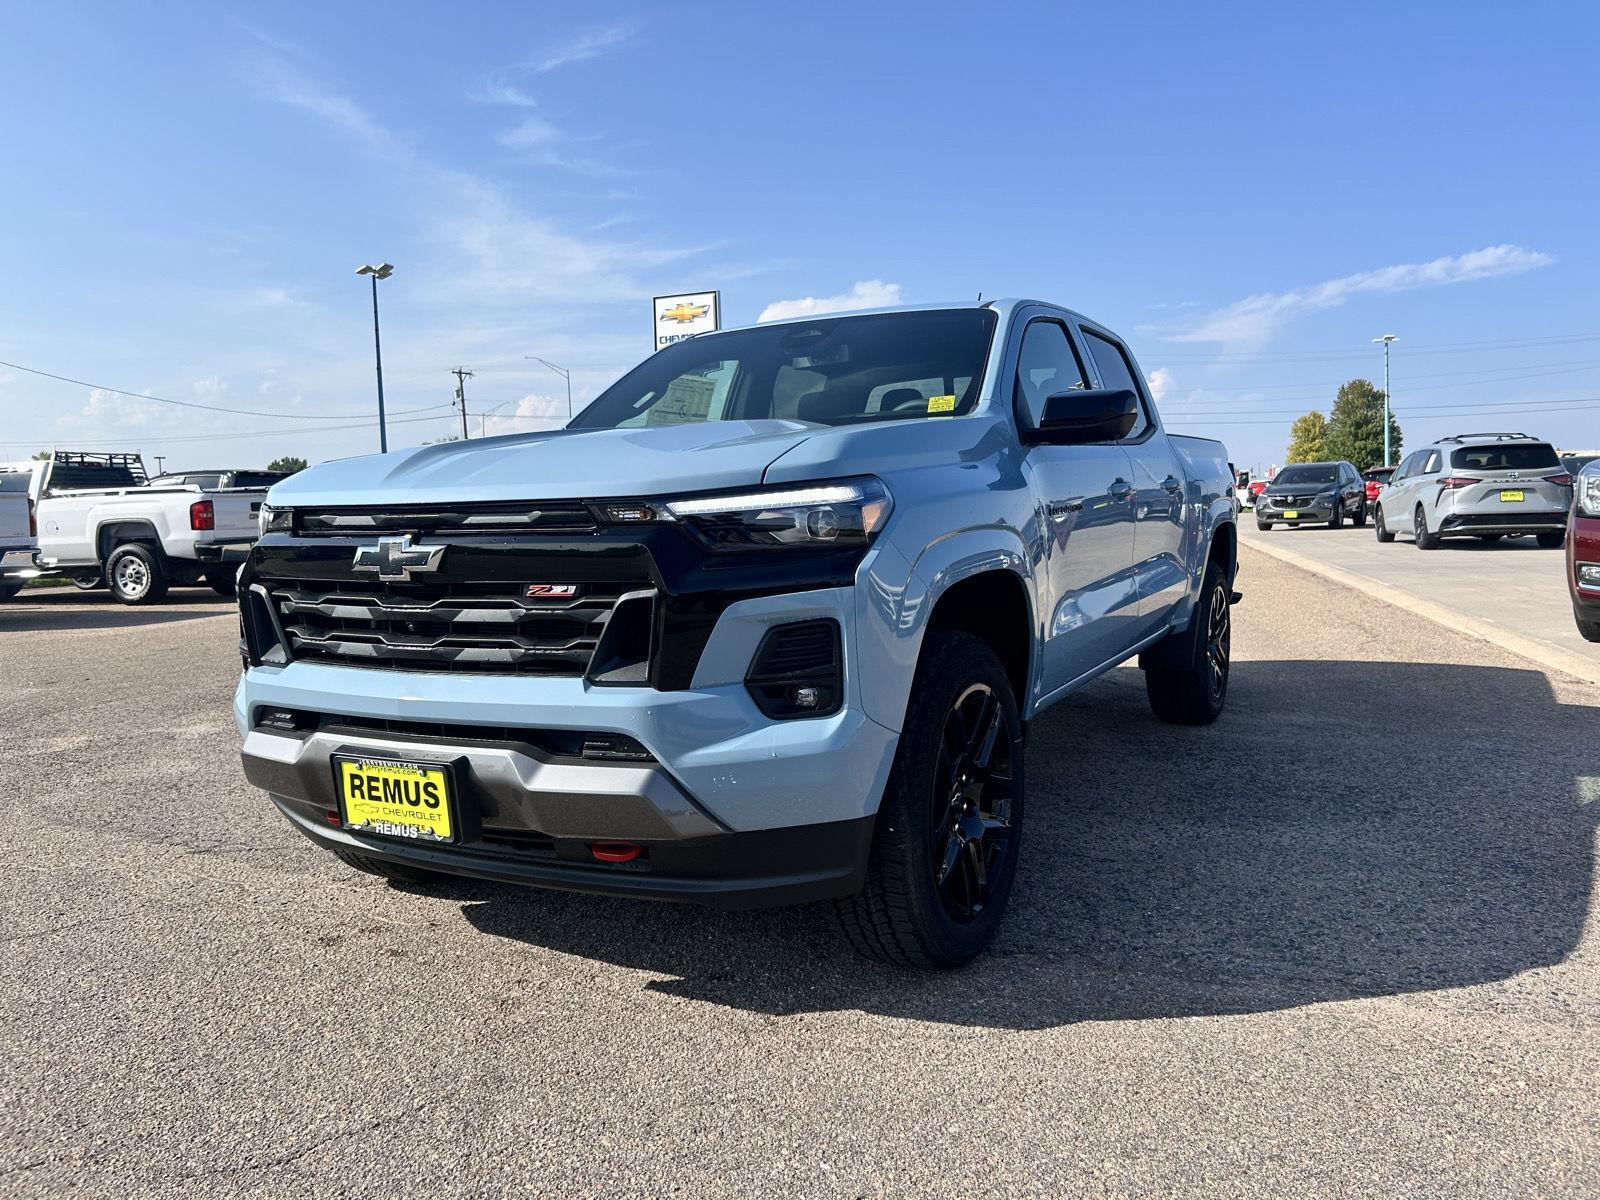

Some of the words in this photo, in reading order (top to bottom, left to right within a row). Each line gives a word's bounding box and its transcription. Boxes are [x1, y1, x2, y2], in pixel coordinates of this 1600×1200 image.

[526, 584, 577, 597] Z71
[349, 773, 440, 809] REMUS
[382, 807, 443, 821] CHEVROLET
[375, 823, 418, 839] REMUS
